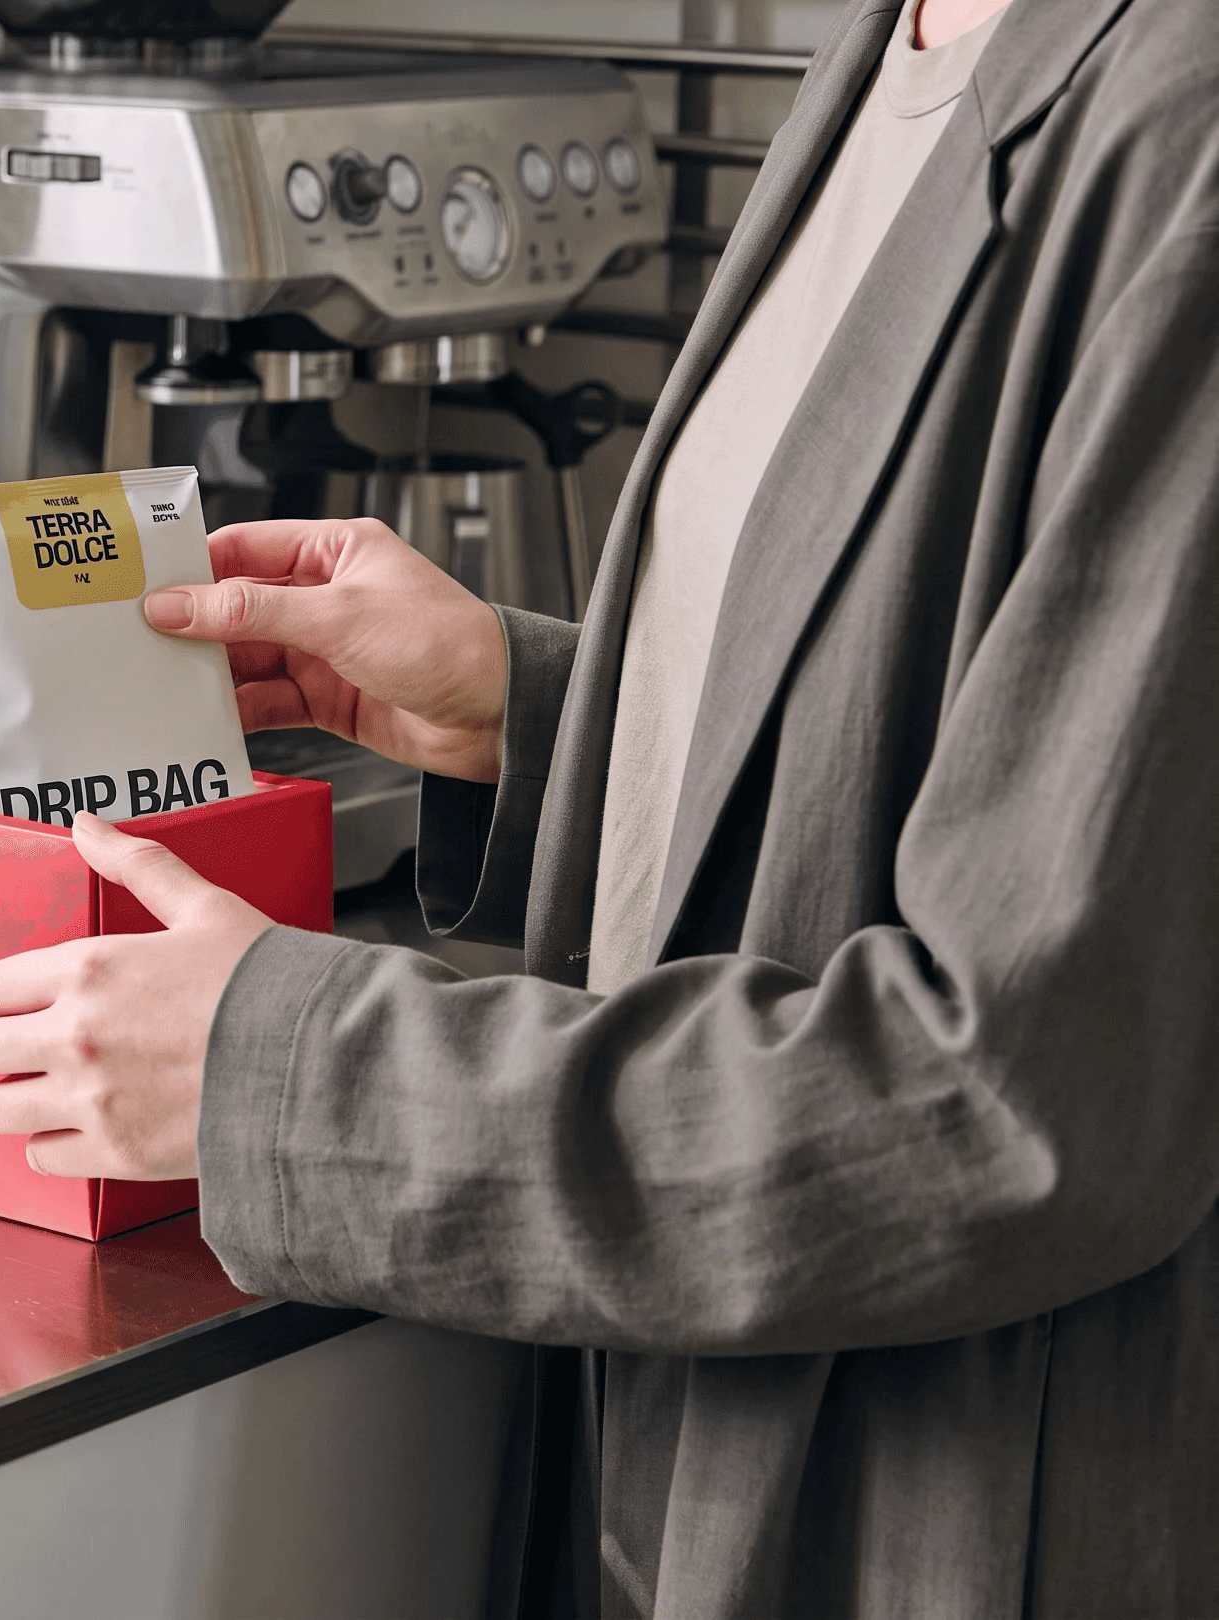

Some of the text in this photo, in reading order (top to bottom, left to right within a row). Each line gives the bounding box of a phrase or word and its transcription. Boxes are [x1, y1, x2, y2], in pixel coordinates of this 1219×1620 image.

[25, 508, 112, 540] TERRA
[33, 534, 119, 569] DOLCE
[0, 758, 230, 829] DRIP BAG
